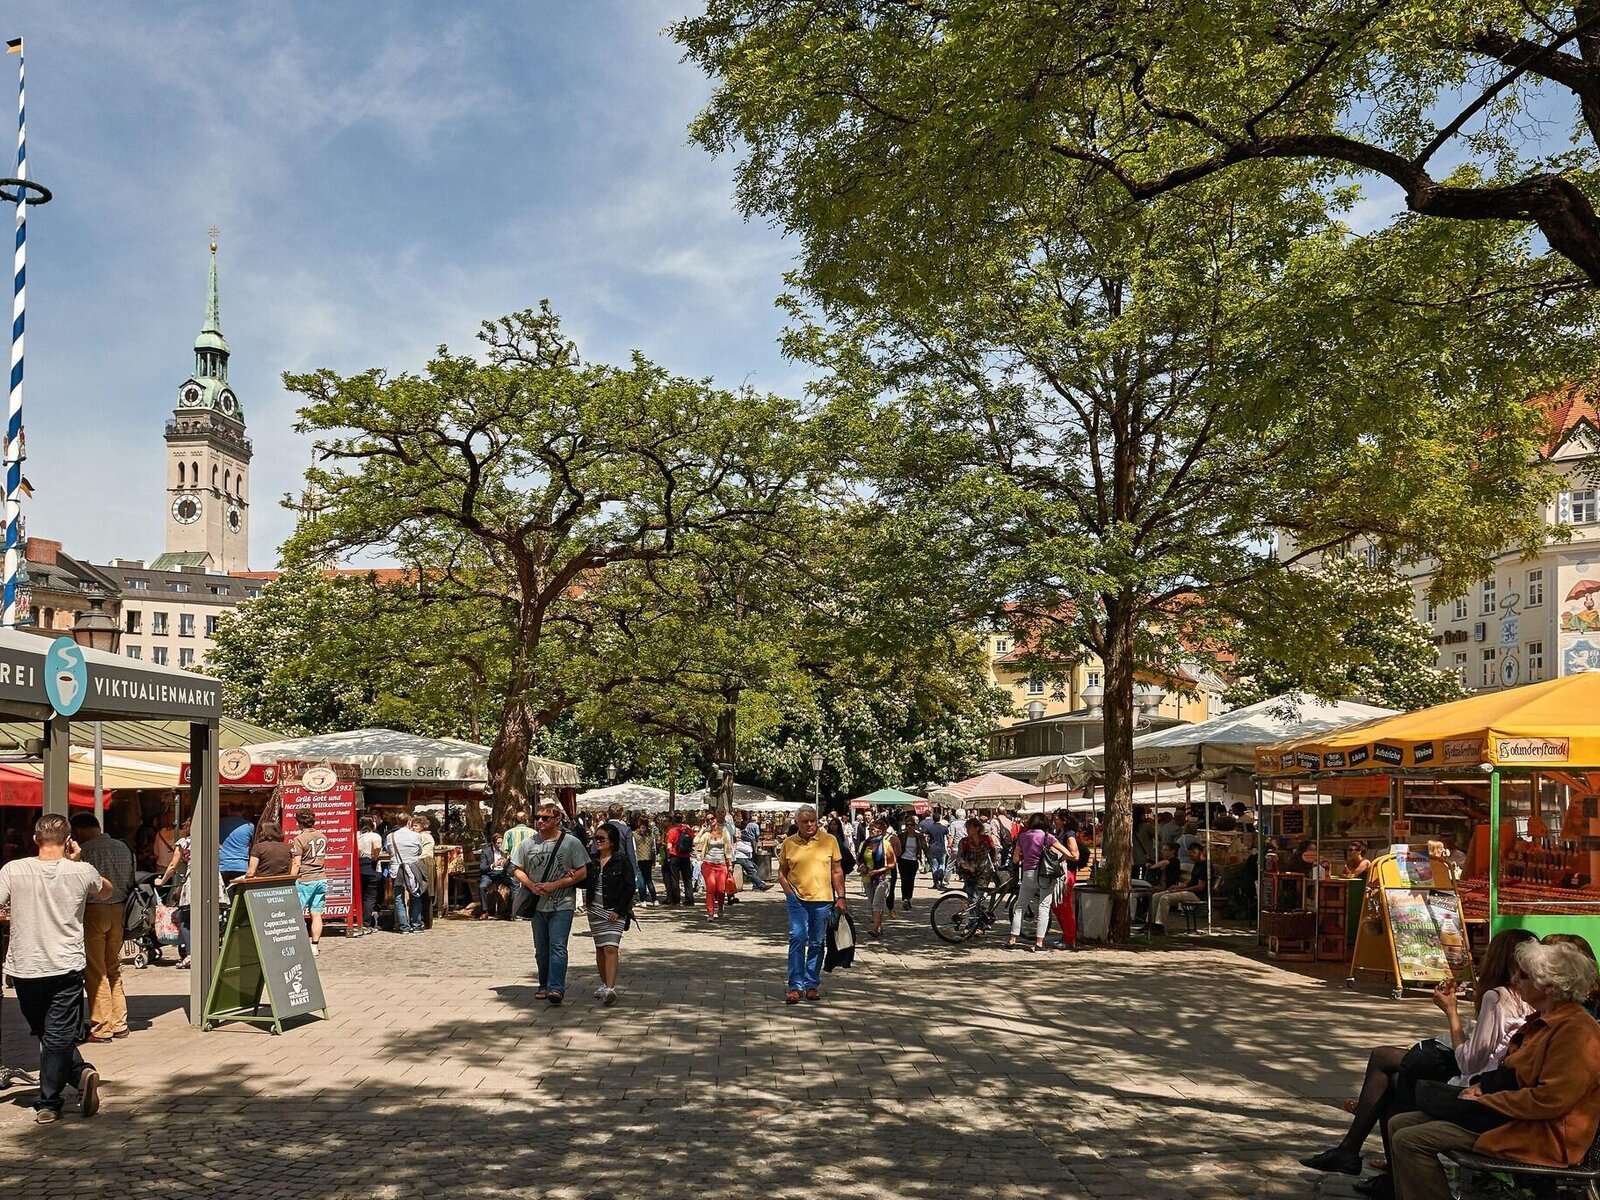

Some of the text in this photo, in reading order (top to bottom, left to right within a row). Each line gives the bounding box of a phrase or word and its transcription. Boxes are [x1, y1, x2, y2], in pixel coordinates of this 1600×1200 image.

[95, 677, 215, 707] VIKTUALIENMARKT
[416, 766, 450, 777] Säfte
[312, 801, 352, 809] Willkommen
[309, 838, 326, 857] 12
[290, 996, 310, 1007] MARKT
